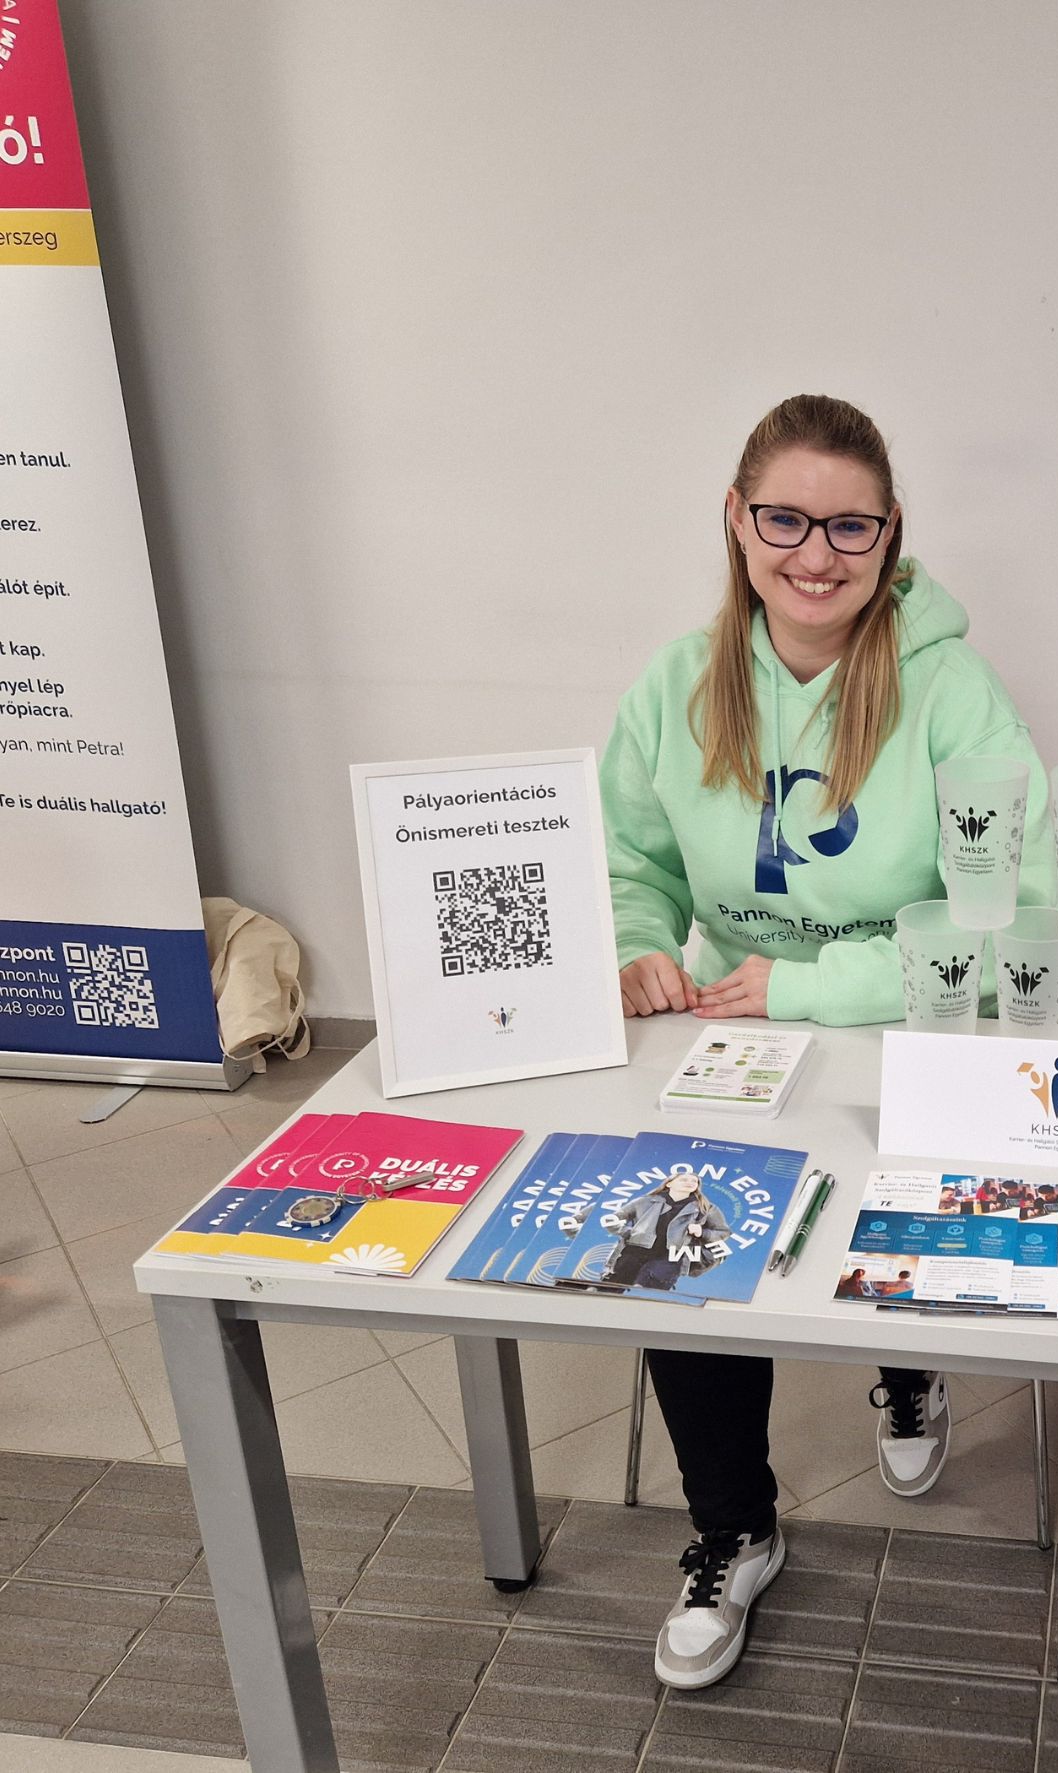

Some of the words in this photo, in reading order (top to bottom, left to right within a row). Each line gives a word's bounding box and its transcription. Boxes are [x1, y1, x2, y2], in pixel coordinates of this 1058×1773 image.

[20, 451, 71, 468] tanul.
[0, 519, 41, 532] erez.
[33, 581, 70, 599] épít.
[9, 641, 45, 660] kap.
[37, 679, 64, 697] lép
[37, 738, 73, 754] mint
[77, 739, 124, 756] Petra!
[19, 795, 32, 809] is
[37, 796, 87, 812] duális
[91, 798, 167, 817] hallgató!
[403, 784, 557, 811] Pályaorientációs
[395, 820, 499, 843] Önismereti
[503, 814, 571, 835] tesztek
[959, 846, 989, 854] KHSZK
[718, 904, 795, 928] Pannon
[801, 917, 896, 939] Egyetem
[727, 923, 805, 944] University
[940, 990, 967, 999] KHSZK
[1012, 997, 1040, 1007] KHSZK
[26, 1003, 65, 1017] 9020
[378, 1156, 481, 1178] DUÁLIS
[600, 1162, 727, 1228] PANNON
[667, 1175, 775, 1263] EGYETEM
